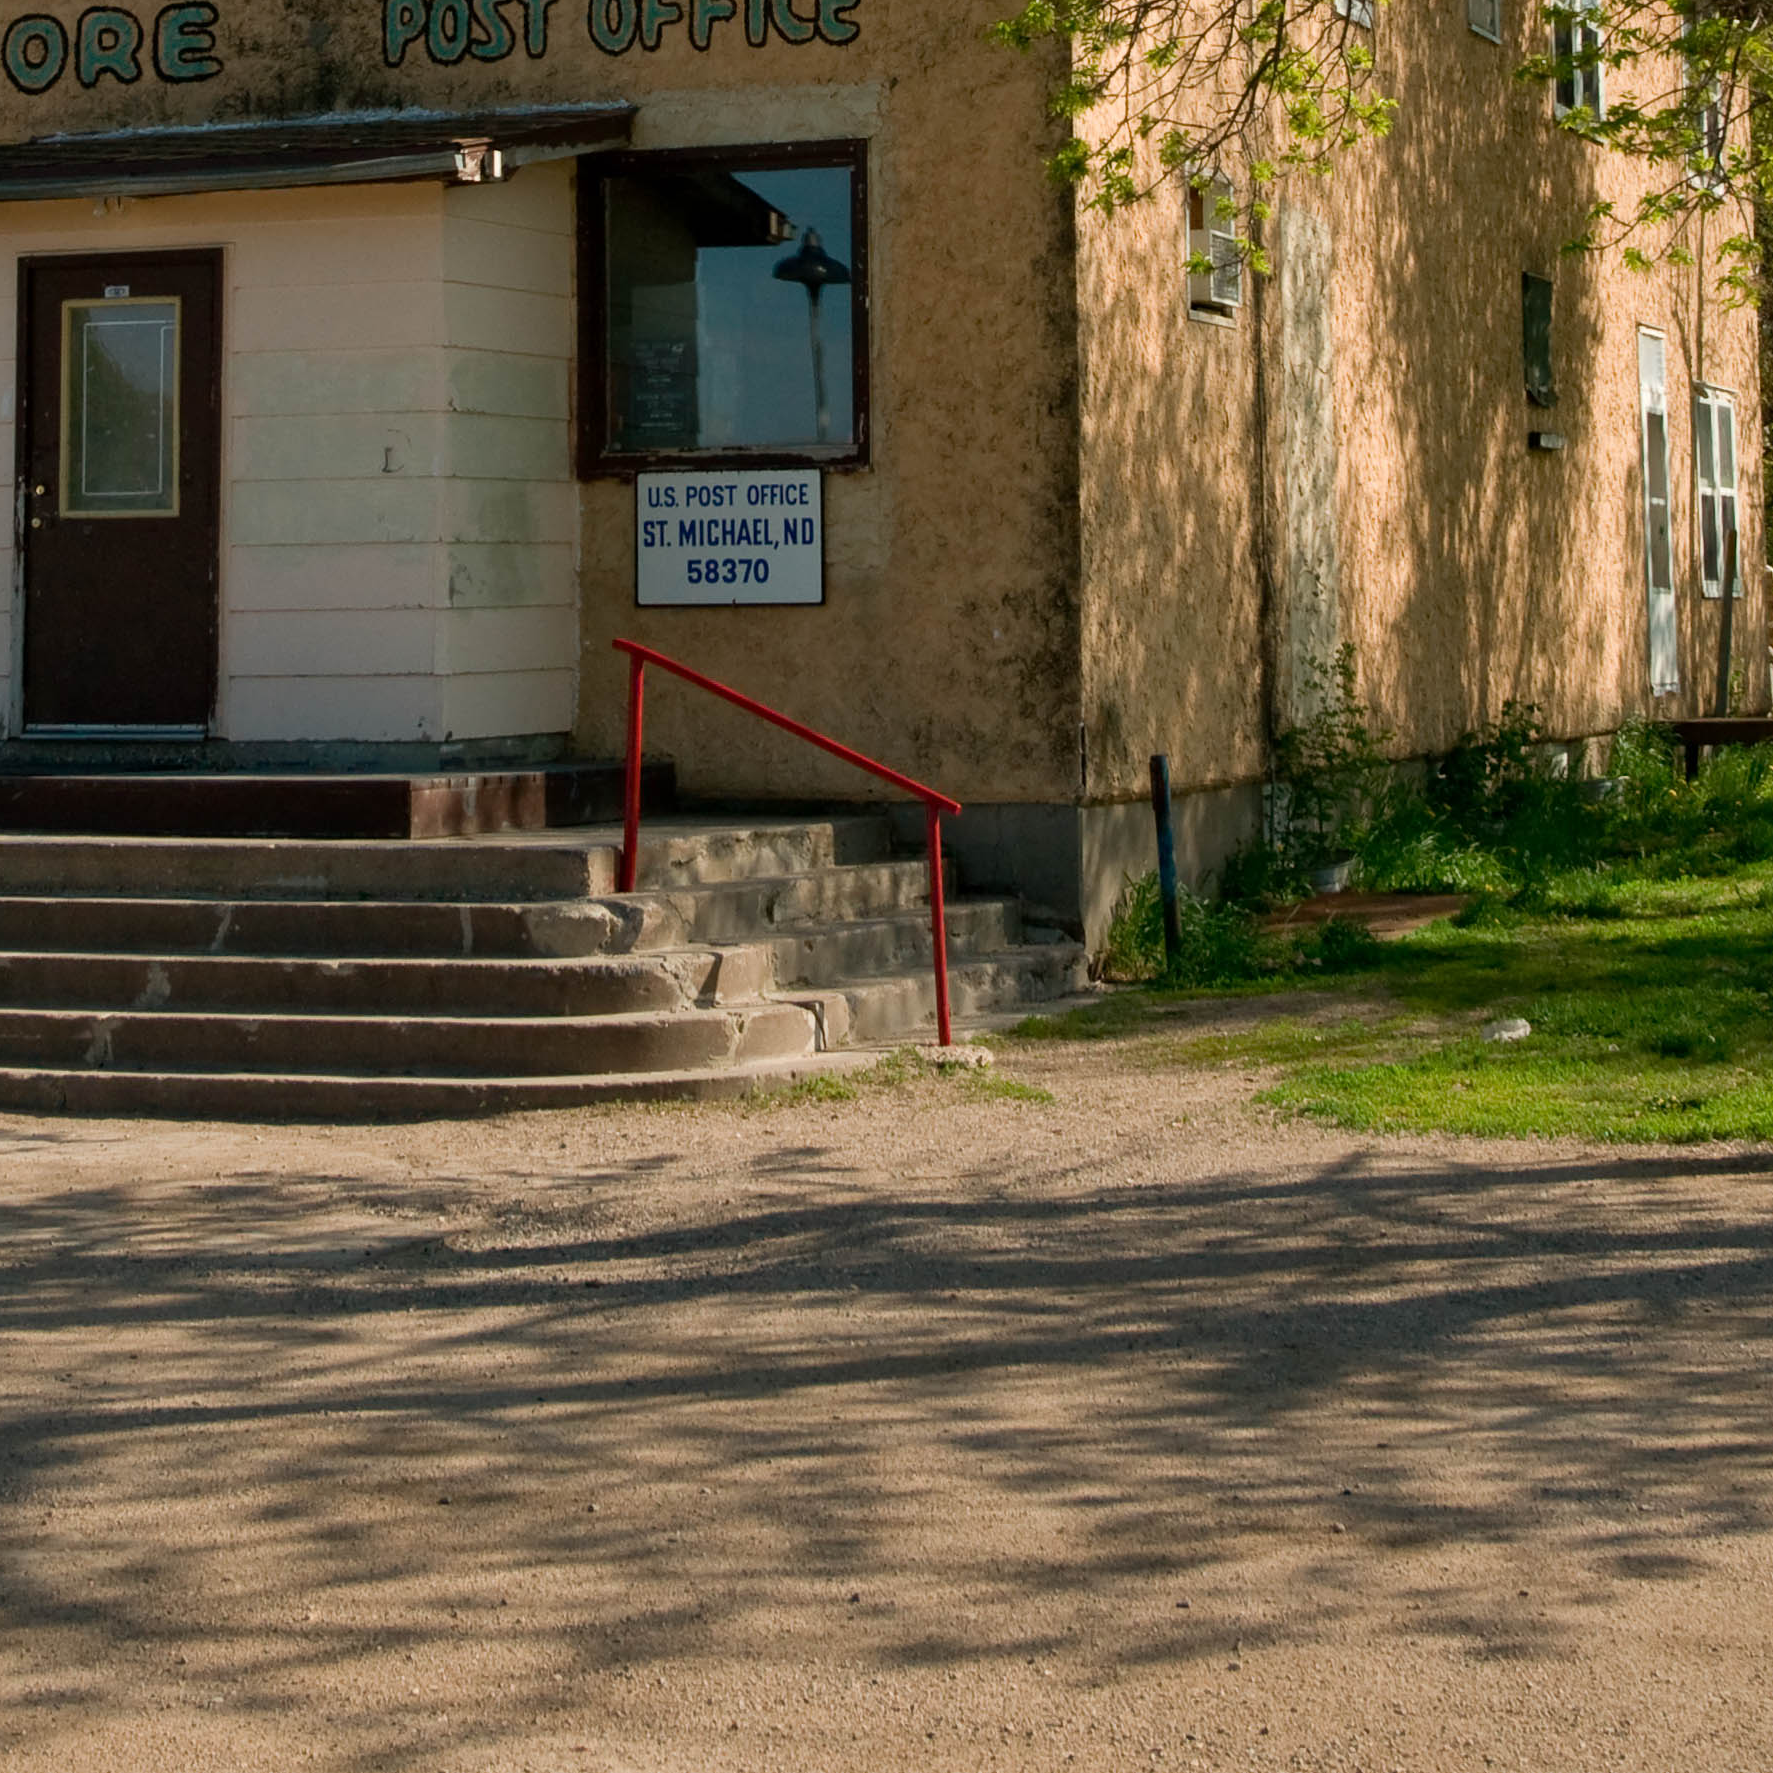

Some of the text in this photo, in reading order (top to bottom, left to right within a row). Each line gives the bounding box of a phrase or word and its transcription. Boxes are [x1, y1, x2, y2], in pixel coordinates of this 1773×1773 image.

[648, 483, 810, 508] U.S. POST OFFICE
[643, 517, 815, 551] ST. MICHAEL, ND
[686, 558, 770, 584] 58370
